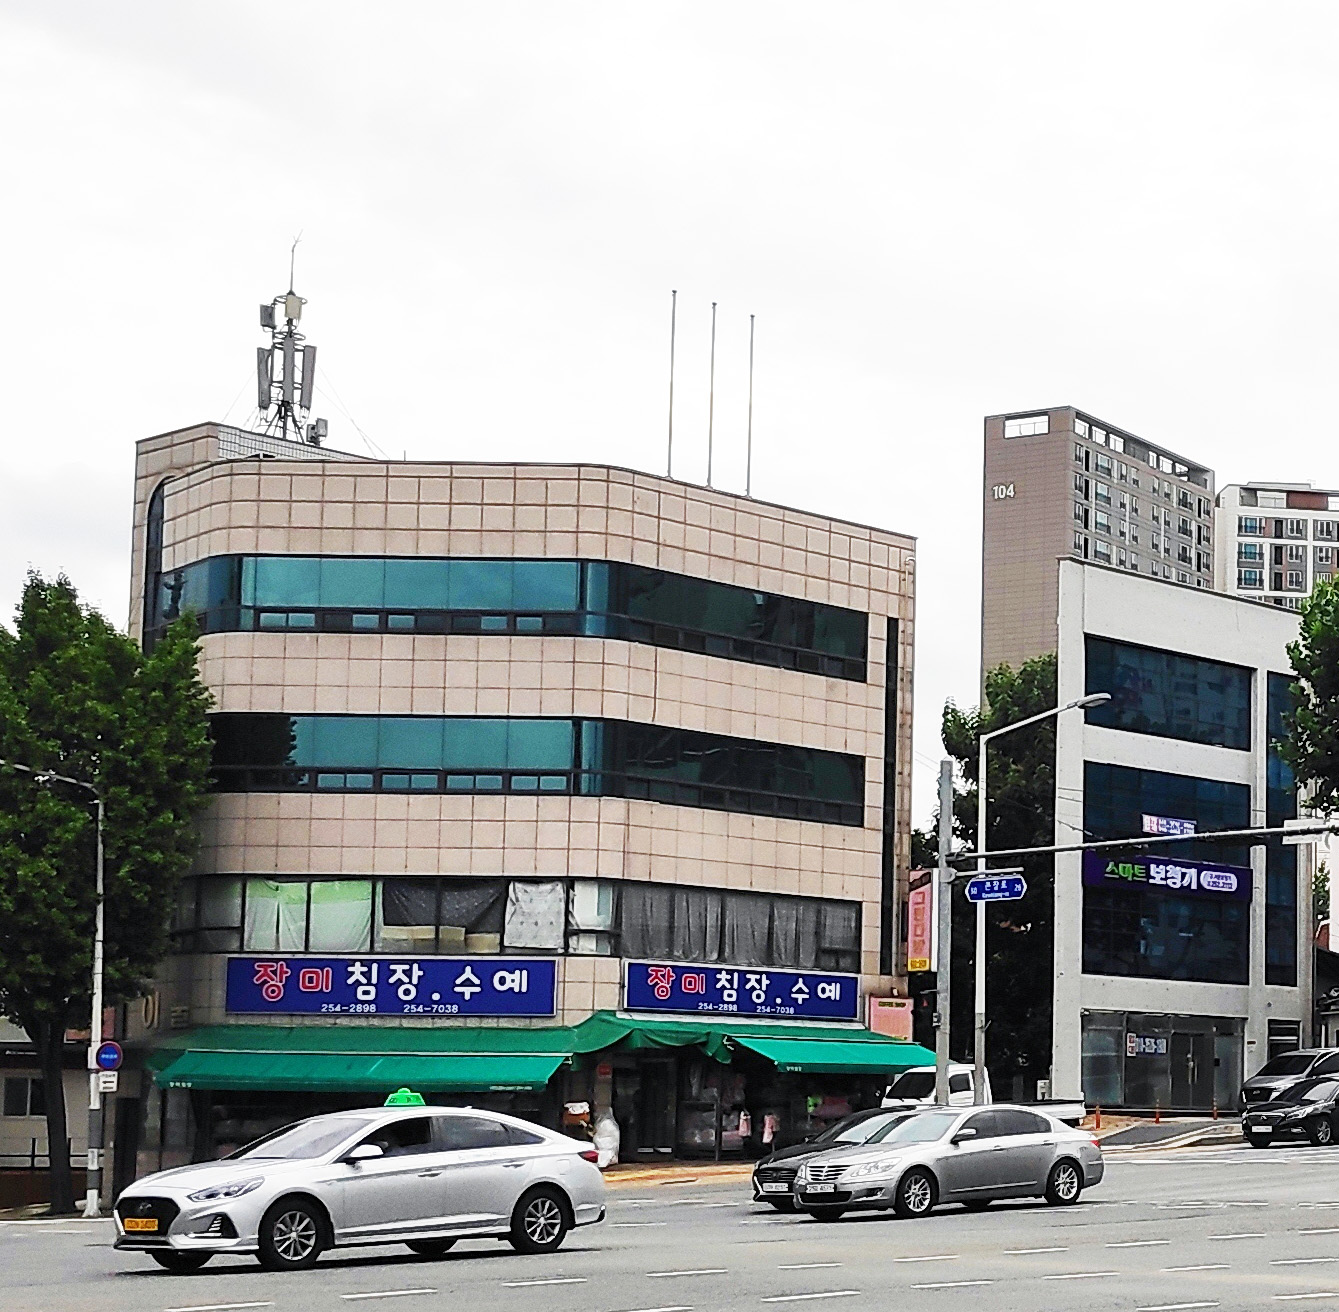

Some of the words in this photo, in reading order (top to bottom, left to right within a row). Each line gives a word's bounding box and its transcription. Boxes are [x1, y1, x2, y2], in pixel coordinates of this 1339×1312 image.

[991, 483, 1015, 500] 104
[1104, 860, 1148, 882] 스마트
[1148, 863, 1198, 890] 보청기
[252, 961, 333, 1001] 장미
[346, 961, 528, 1001] 침장.수예
[647, 966, 706, 1000] 장미
[715, 970, 841, 1005] 침장.수예
[320, 1003, 377, 1013] 254-2898
[402, 1003, 459, 1014] 254-7038
[698, 1002, 738, 1012] 254-2898
[756, 1005, 795, 1015] 254-7038
